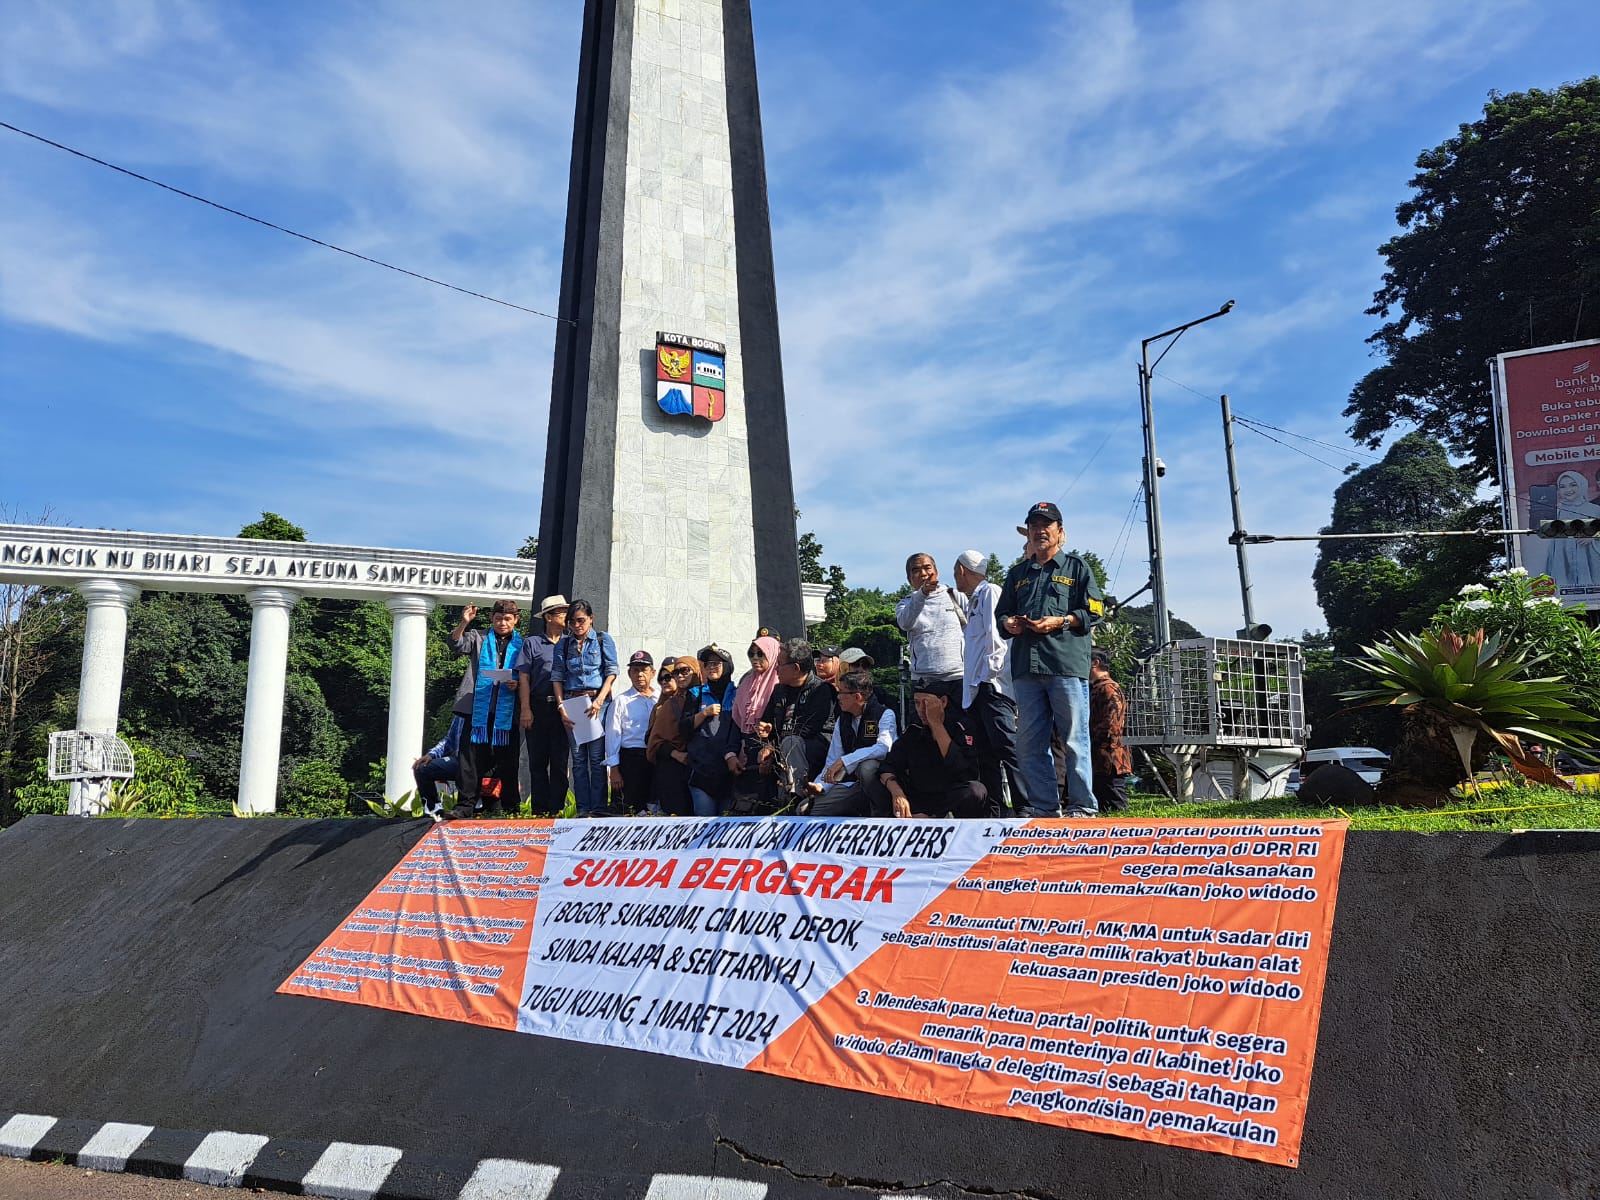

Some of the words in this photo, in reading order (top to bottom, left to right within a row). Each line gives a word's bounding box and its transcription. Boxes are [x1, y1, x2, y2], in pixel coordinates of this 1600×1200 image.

[663, 333, 688, 345] KOTA
[691, 337, 720, 352] BOGOR
[1555, 375, 1587, 388] bank
[1541, 401, 1572, 412] Buka
[1544, 415, 1560, 423] Ga
[1562, 411, 1592, 423] pake
[1516, 425, 1575, 439] Download
[1584, 434, 1596, 443] di
[1535, 450, 1580, 462] Mobile
[3, 544, 97, 567] NGANCIK
[105, 550, 134, 569] NU
[142, 552, 211, 572] BIHARI
[225, 556, 276, 576] SEJA
[287, 560, 358, 579] AYEUNA
[366, 564, 488, 587] SAMPEUREUN
[495, 573, 531, 591] JAGA
[573, 825, 668, 852] PERNYATAAN
[656, 823, 704, 850] SIKAP
[696, 821, 766, 850] POLITIK
[754, 822, 800, 850] DAN
[792, 823, 907, 857] KONFERENSI
[899, 826, 955, 859] PERS
[982, 827, 995, 838] 1.
[1000, 827, 1069, 838] Mendesak
[1072, 828, 1105, 840] para
[1109, 826, 1153, 838] ketua
[1269, 825, 1322, 837] untuk
[989, 842, 1108, 857] mengintruksikan
[1111, 844, 1147, 858] para
[1151, 843, 1226, 858] kadernya
[1231, 843, 1249, 856] di
[1252, 842, 1292, 856] DPR
[1297, 843, 1317, 857] RI
[563, 858, 678, 888] SUNDA
[678, 858, 906, 903] BERGERAK
[1121, 864, 1178, 879] segera
[1182, 862, 1314, 878] melaksanakan
[986, 878, 1038, 893] angket
[1040, 880, 1083, 893] untuk
[1086, 882, 1200, 897] memakzulkan
[1202, 884, 1243, 900] joko
[1249, 884, 1316, 900] widodo
[543, 901, 561, 927] (
[554, 901, 613, 928] BOGOR,
[611, 902, 705, 934] SUKABUMI,
[705, 907, 787, 943] CIANJUR,
[789, 914, 863, 951] DEPOK,
[928, 913, 942, 925] 2.
[945, 914, 1016, 931] Menuntut
[1019, 918, 1083, 935] TNI,Polri
[1096, 921, 1157, 940] MK,MA
[1162, 927, 1213, 942] untuk
[1217, 930, 1271, 946] sadar
[1276, 931, 1309, 948] diri
[541, 938, 602, 964] SUNDA
[597, 941, 666, 969] KALAPA
[663, 946, 685, 972] &
[681, 948, 802, 985] SEKITARNYA
[795, 961, 815, 992] )
[881, 930, 935, 946] sebagai
[936, 933, 995, 949] institusi
[996, 938, 1026, 952] alat
[1030, 943, 1085, 958] negara
[1089, 944, 1131, 960] milik
[1135, 947, 1191, 966] rakyat
[1196, 950, 1254, 969] bukan
[1259, 954, 1300, 973] alat
[1010, 960, 1097, 981] kekuasaan
[1101, 970, 1178, 989] presiden
[1180, 973, 1225, 994] joko
[1230, 977, 1301, 999] widodo
[521, 984, 573, 1013] TUGU
[565, 988, 642, 1028] KUJANG,
[639, 998, 660, 1025] 1
[654, 999, 729, 1036] MARET
[722, 1008, 779, 1044] 2024
[857, 991, 870, 1004] 3.
[873, 993, 947, 1013] Mendesak
[949, 1003, 985, 1018] para
[988, 1004, 1033, 1024] ketua
[1036, 1013, 1090, 1031] partai
[1093, 1018, 1152, 1039] politik
[1156, 1026, 1211, 1044] untuk
[1215, 1033, 1286, 1054] segera
[921, 1023, 985, 1043] menarik
[987, 1032, 1026, 1049] para
[1029, 1038, 1128, 1065] menterinya
[1133, 1049, 1151, 1065] di
[1156, 1049, 1231, 1076] kabinet
[1233, 1060, 1281, 1083] joko
[834, 1034, 885, 1053] widodo
[887, 1041, 933, 1061] dalam
[936, 1050, 992, 1070] rangka
[995, 1056, 1103, 1087] delegitimasi
[1107, 1073, 1186, 1099] sebagai
[1189, 1084, 1277, 1113] tahapan
[1008, 1087, 1144, 1123] pengkondisian
[1149, 1109, 1277, 1145] pemakzulan
